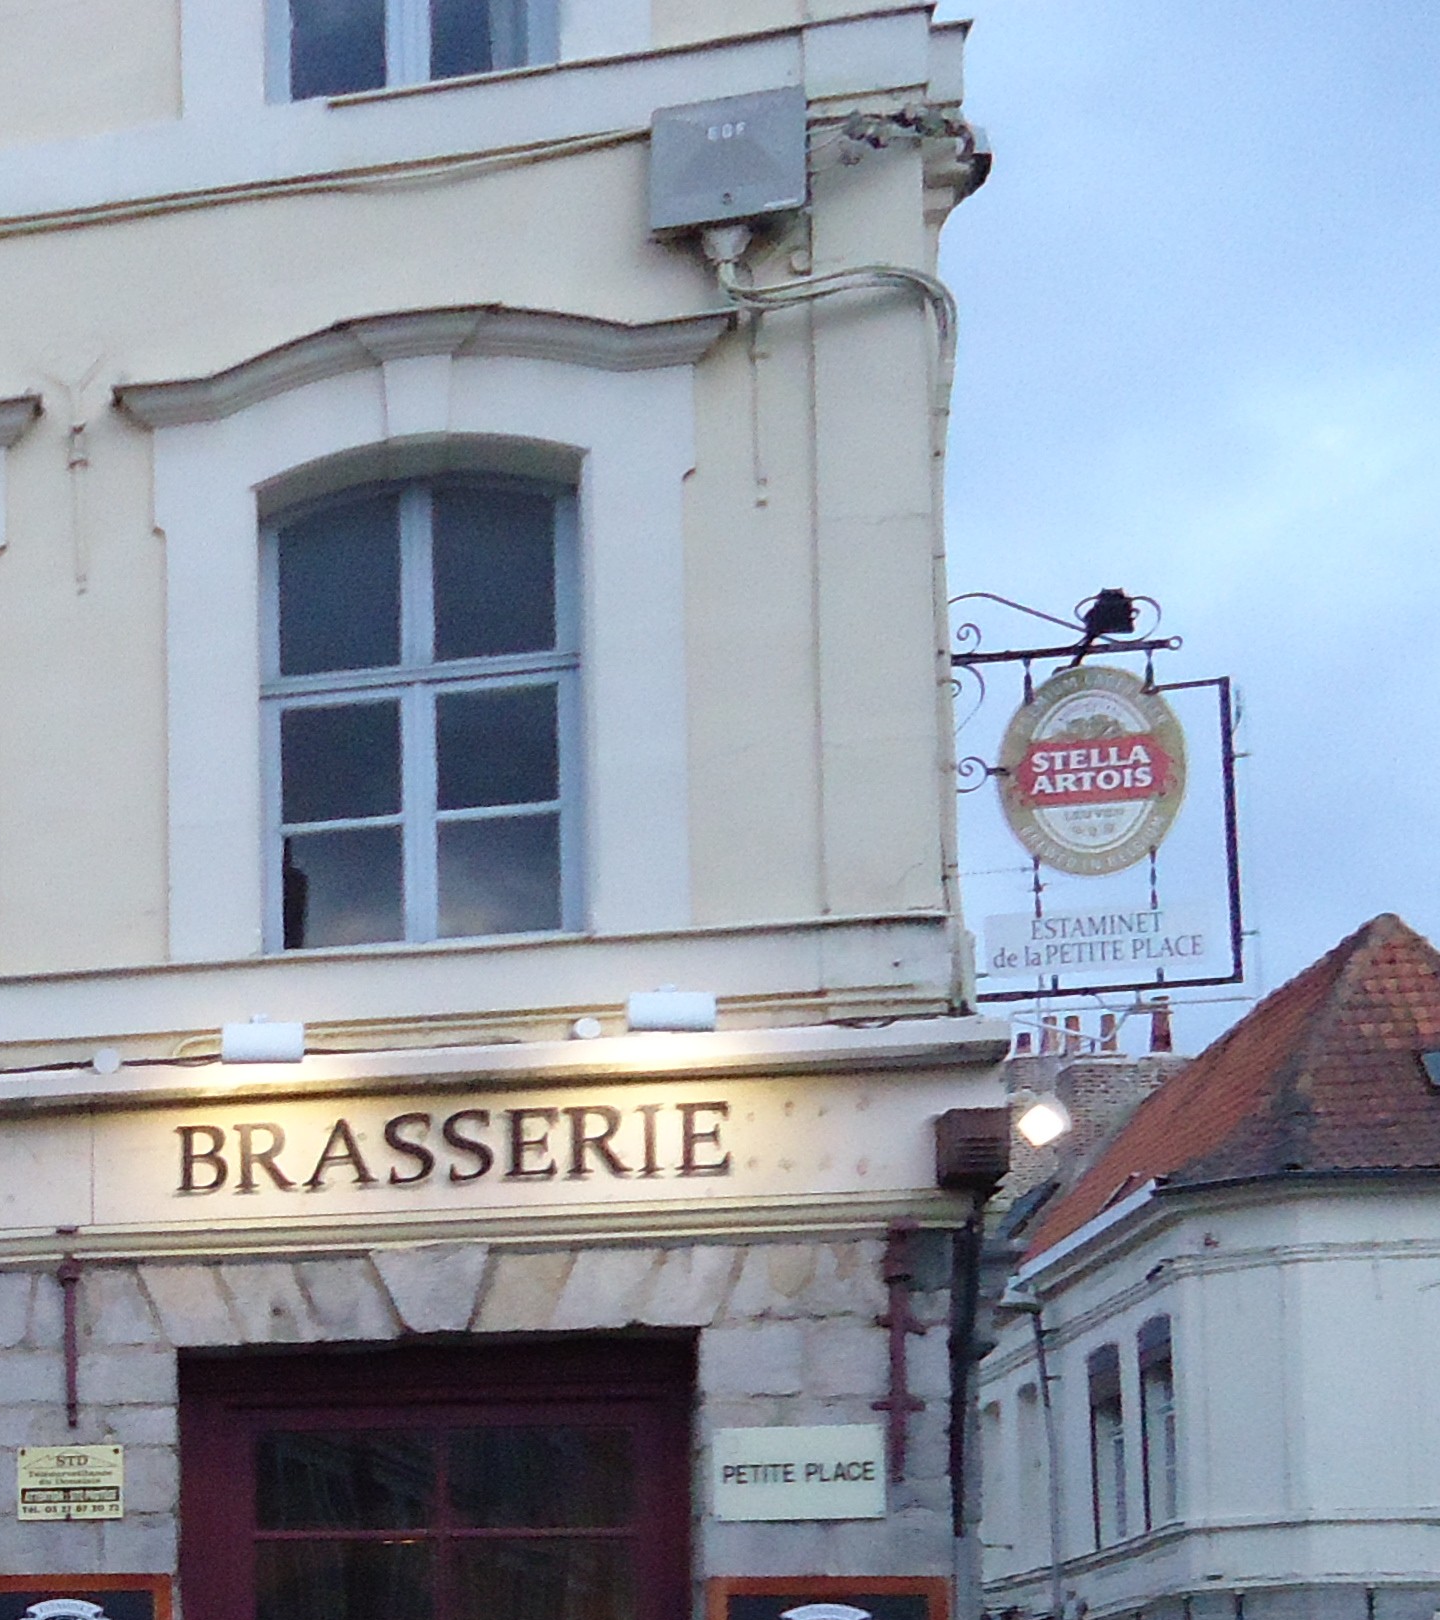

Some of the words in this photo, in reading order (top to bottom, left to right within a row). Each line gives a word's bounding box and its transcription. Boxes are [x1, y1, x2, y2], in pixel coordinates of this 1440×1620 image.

[1031, 745, 1151, 773] STELLA
[1031, 768, 1153, 795] ARTOIS
[1031, 911, 1163, 940] ESTAMINET
[993, 947, 1018, 968] de
[1024, 946, 1041, 967] la
[1046, 940, 1126, 965] PETITE
[1131, 934, 1203, 960] PLACE
[175, 1100, 733, 1193] BRASSERIE
[722, 1463, 796, 1485] PETITE
[805, 1460, 876, 1483] PLACE
